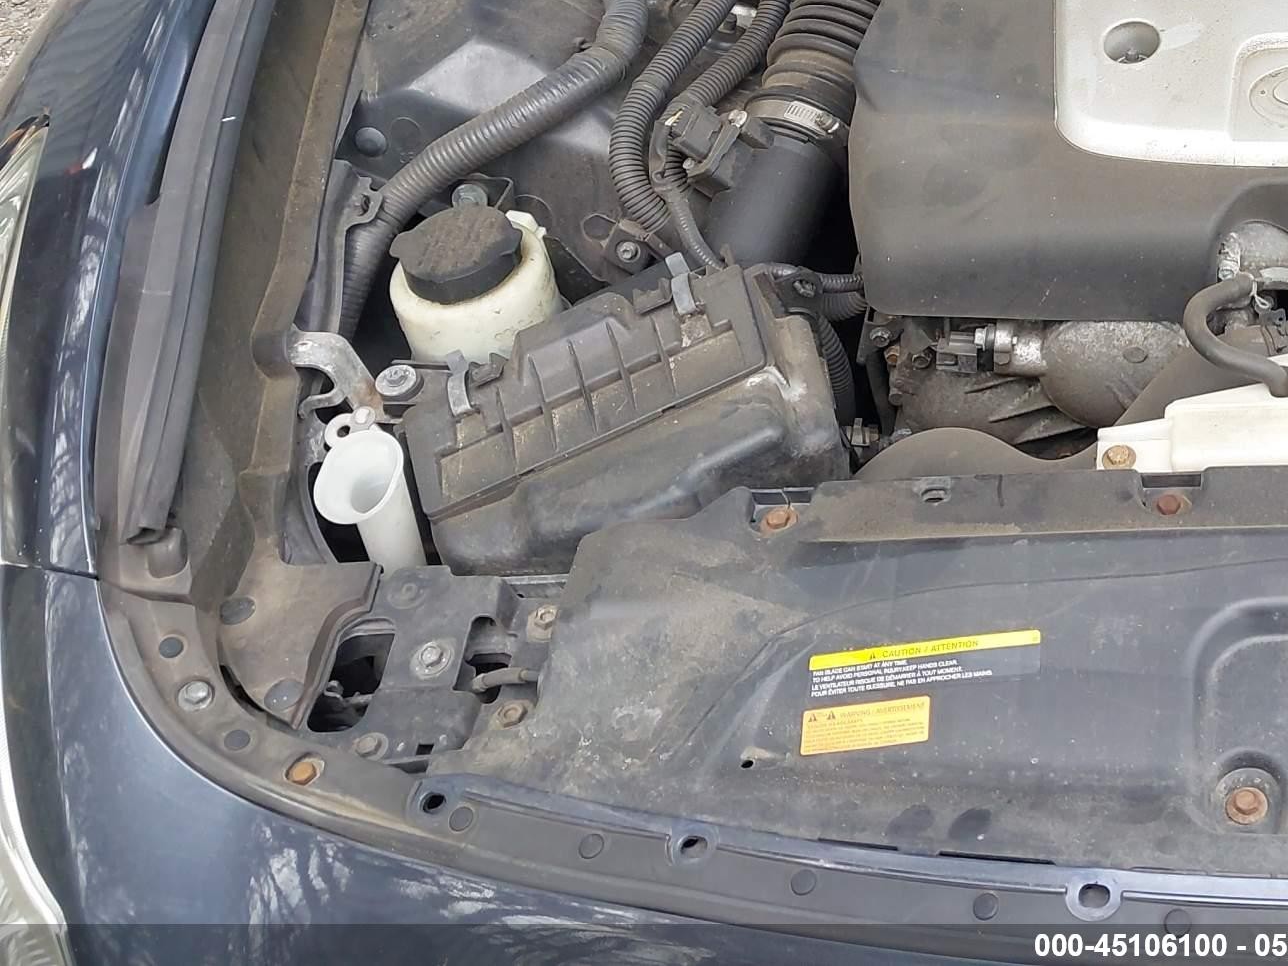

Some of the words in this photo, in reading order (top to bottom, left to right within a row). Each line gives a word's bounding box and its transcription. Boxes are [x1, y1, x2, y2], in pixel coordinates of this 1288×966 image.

[882, 646, 921, 658] CAUTION
[931, 640, 979, 652] ATTENTION
[836, 673, 853, 681] AVOID
[853, 669, 883, 678] PERSONAL
[917, 661, 938, 670] HANDS
[820, 680, 855, 690] VENTILATEUR
[847, 685, 865, 693] TOUTE
[926, 673, 962, 682] APPROCHER
